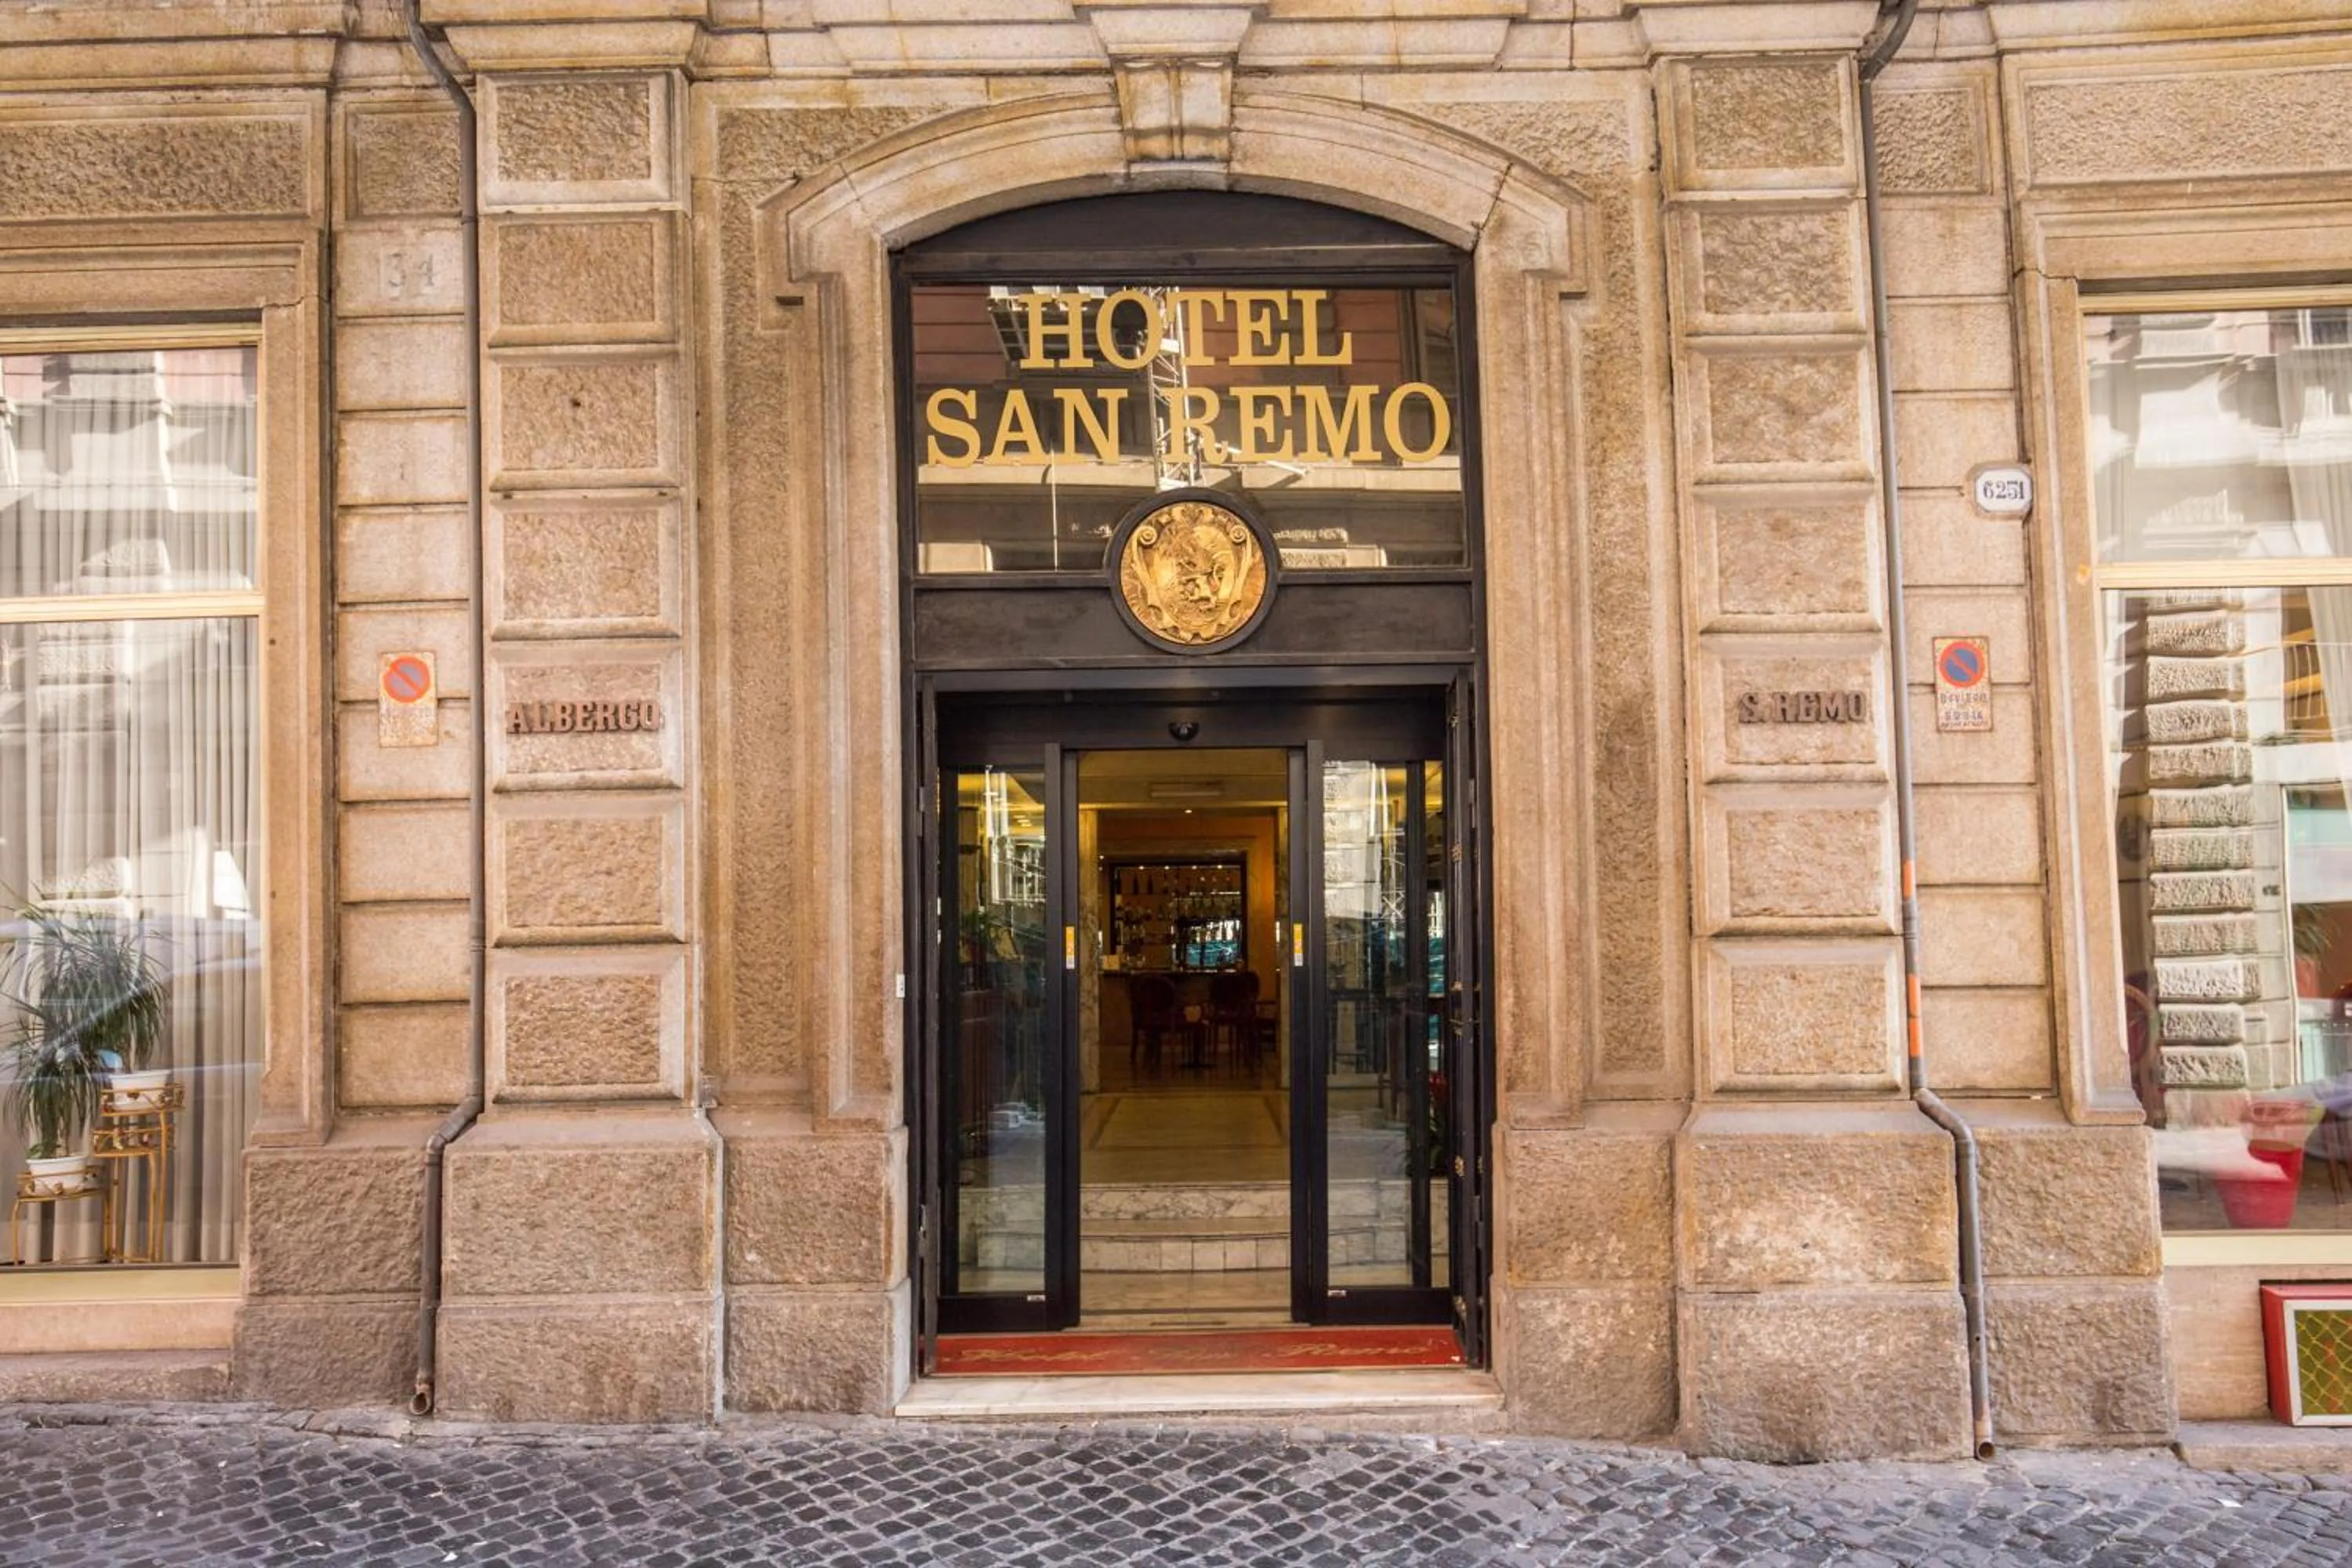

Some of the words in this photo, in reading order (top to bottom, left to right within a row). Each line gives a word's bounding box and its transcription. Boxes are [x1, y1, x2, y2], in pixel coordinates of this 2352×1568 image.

[1019, 289, 1352, 369] HOTEL
[926, 389, 1127, 467] SAN
[1171, 382, 1451, 464] REMO
[1982, 479, 2025, 500] 6251
[506, 701, 662, 735] ALBERGO
[1772, 690, 1867, 724] REMO
